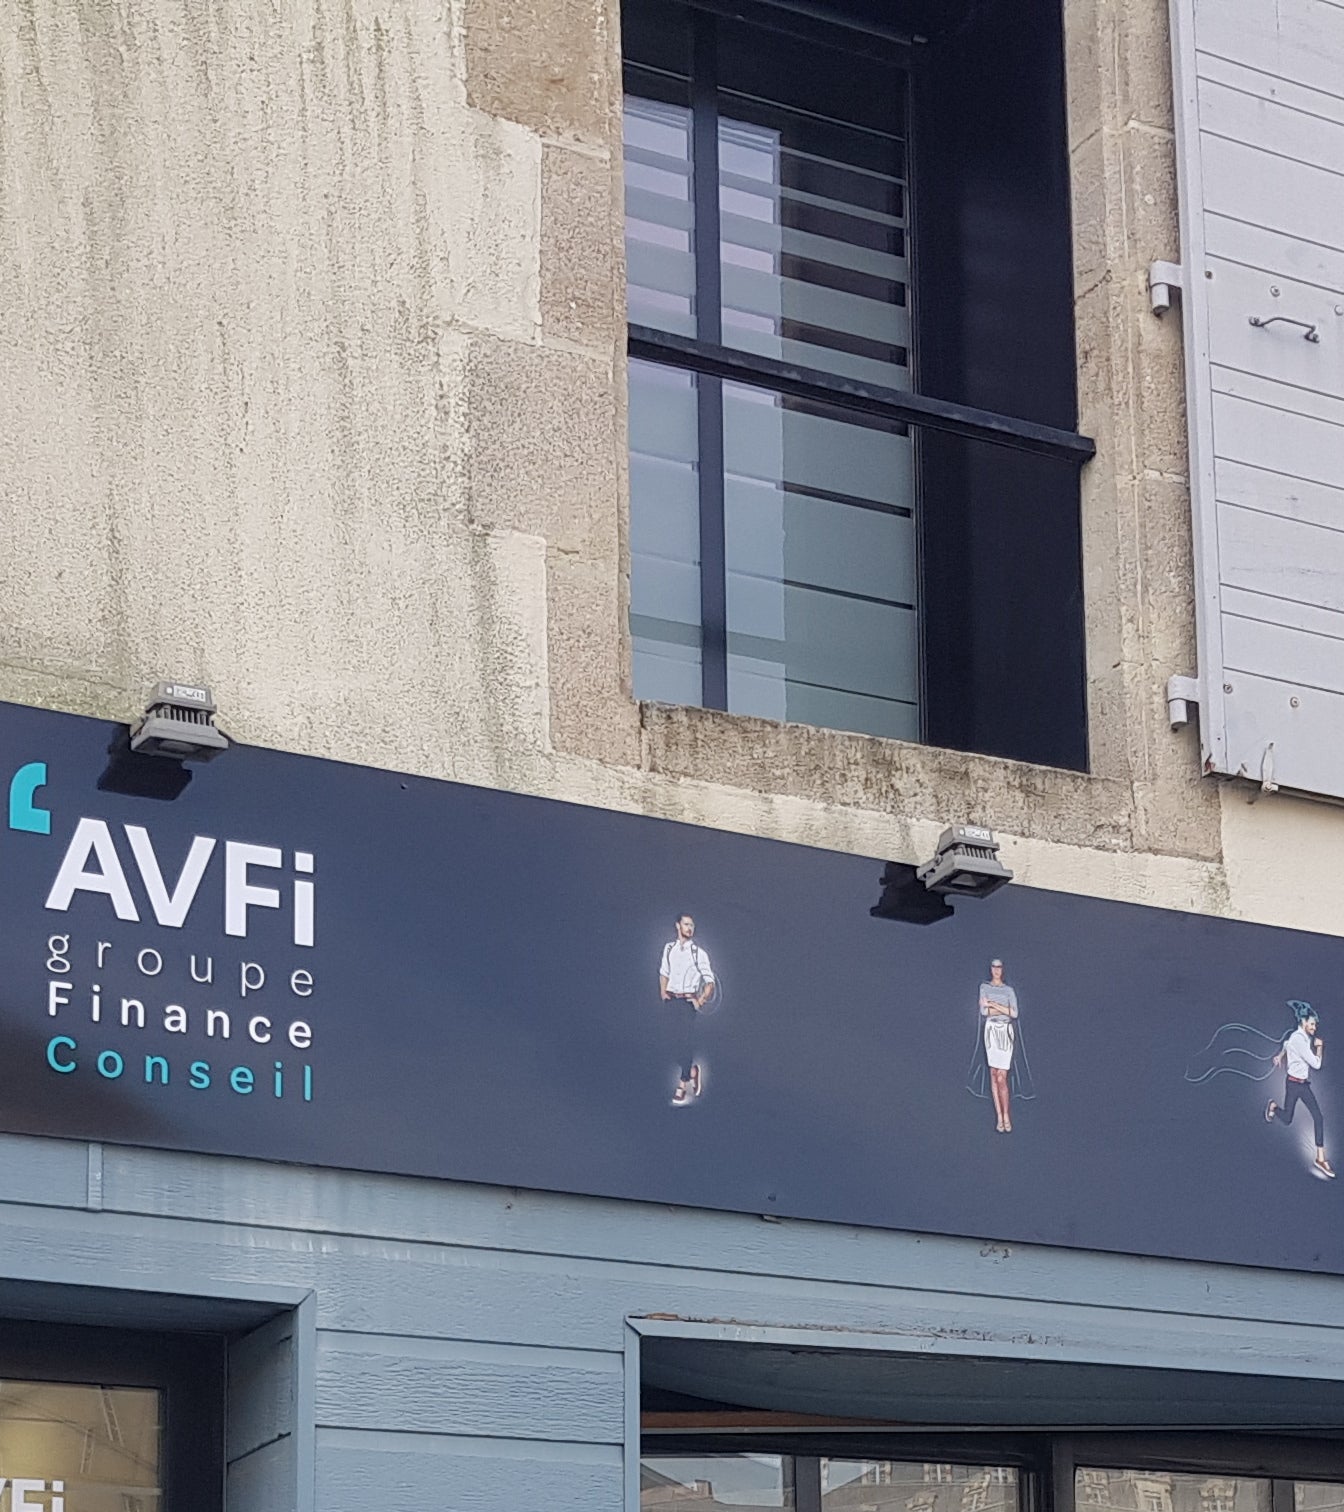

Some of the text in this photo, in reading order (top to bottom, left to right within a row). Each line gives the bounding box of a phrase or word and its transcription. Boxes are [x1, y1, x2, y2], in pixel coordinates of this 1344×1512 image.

[45, 817, 315, 947] AVFi
[48, 933, 315, 997] groupe
[48, 981, 313, 1048] Finance
[46, 1035, 313, 1101] Conseil
